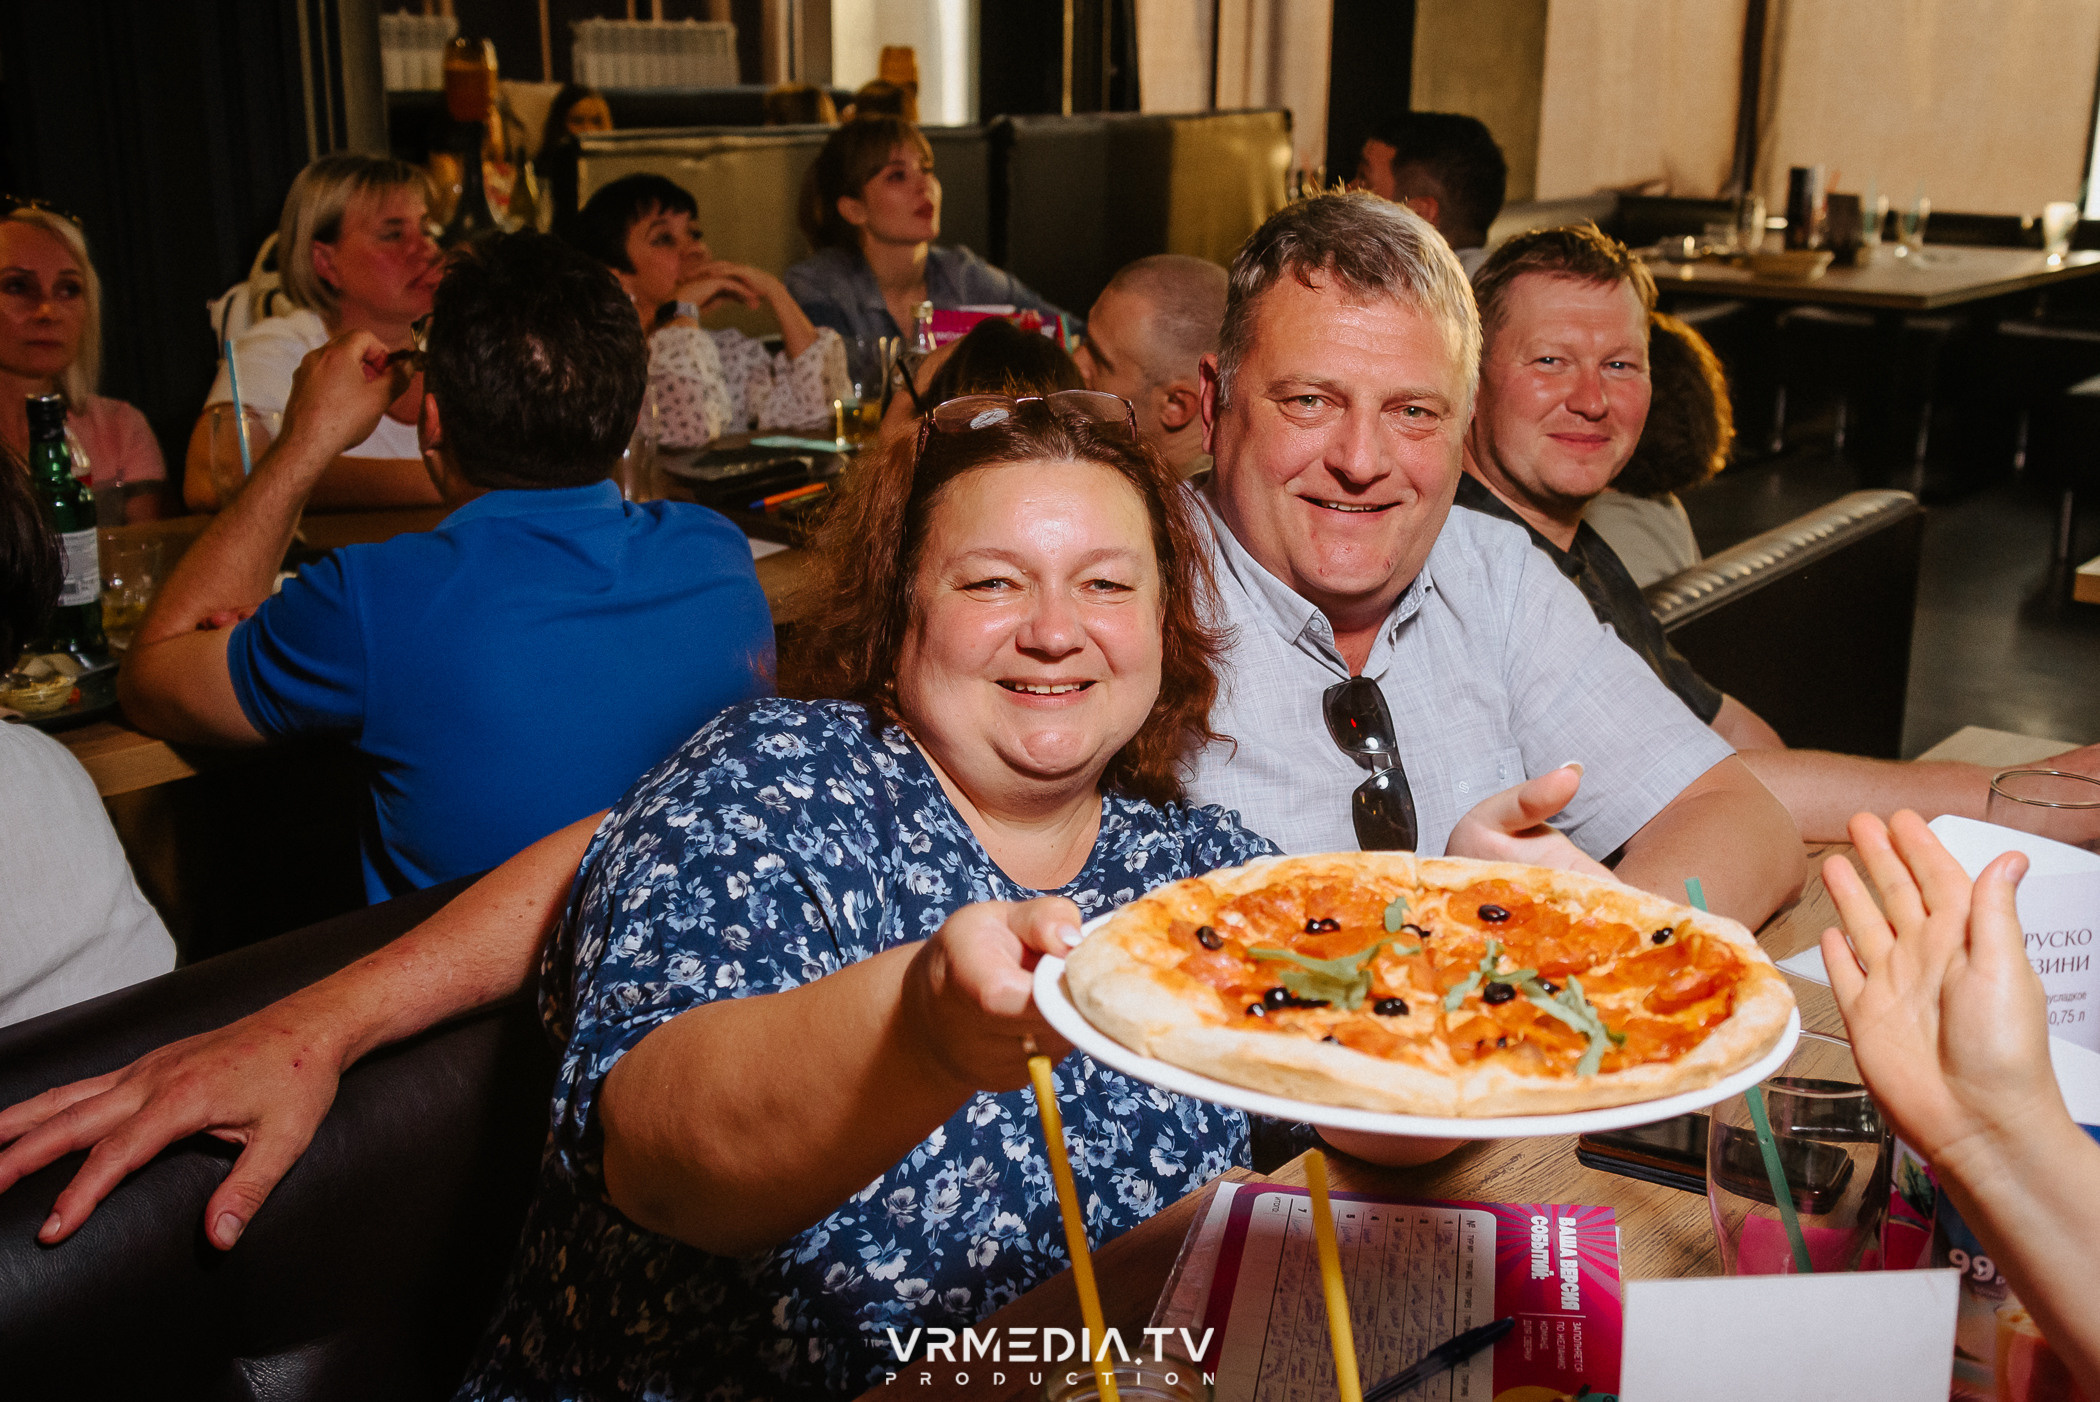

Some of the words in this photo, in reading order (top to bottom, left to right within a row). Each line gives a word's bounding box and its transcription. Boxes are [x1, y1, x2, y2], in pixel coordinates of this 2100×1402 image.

[2024, 928, 2092, 951] РУСКО
[2028, 955, 2090, 975] ЗИНИ
[2049, 1009, 2075, 1026] 0,75
[2078, 1011, 2086, 1022] л
[1530, 1215, 1554, 1280] СОБЫТИЙ:
[1558, 1216, 1578, 1258] ВАША
[1560, 1259, 1580, 1310] ВЕРСИЯ
[1556, 1321, 1565, 1332] ПО
[1572, 1321, 1583, 1372] ЗАПОЛНЯЕТСЯ
